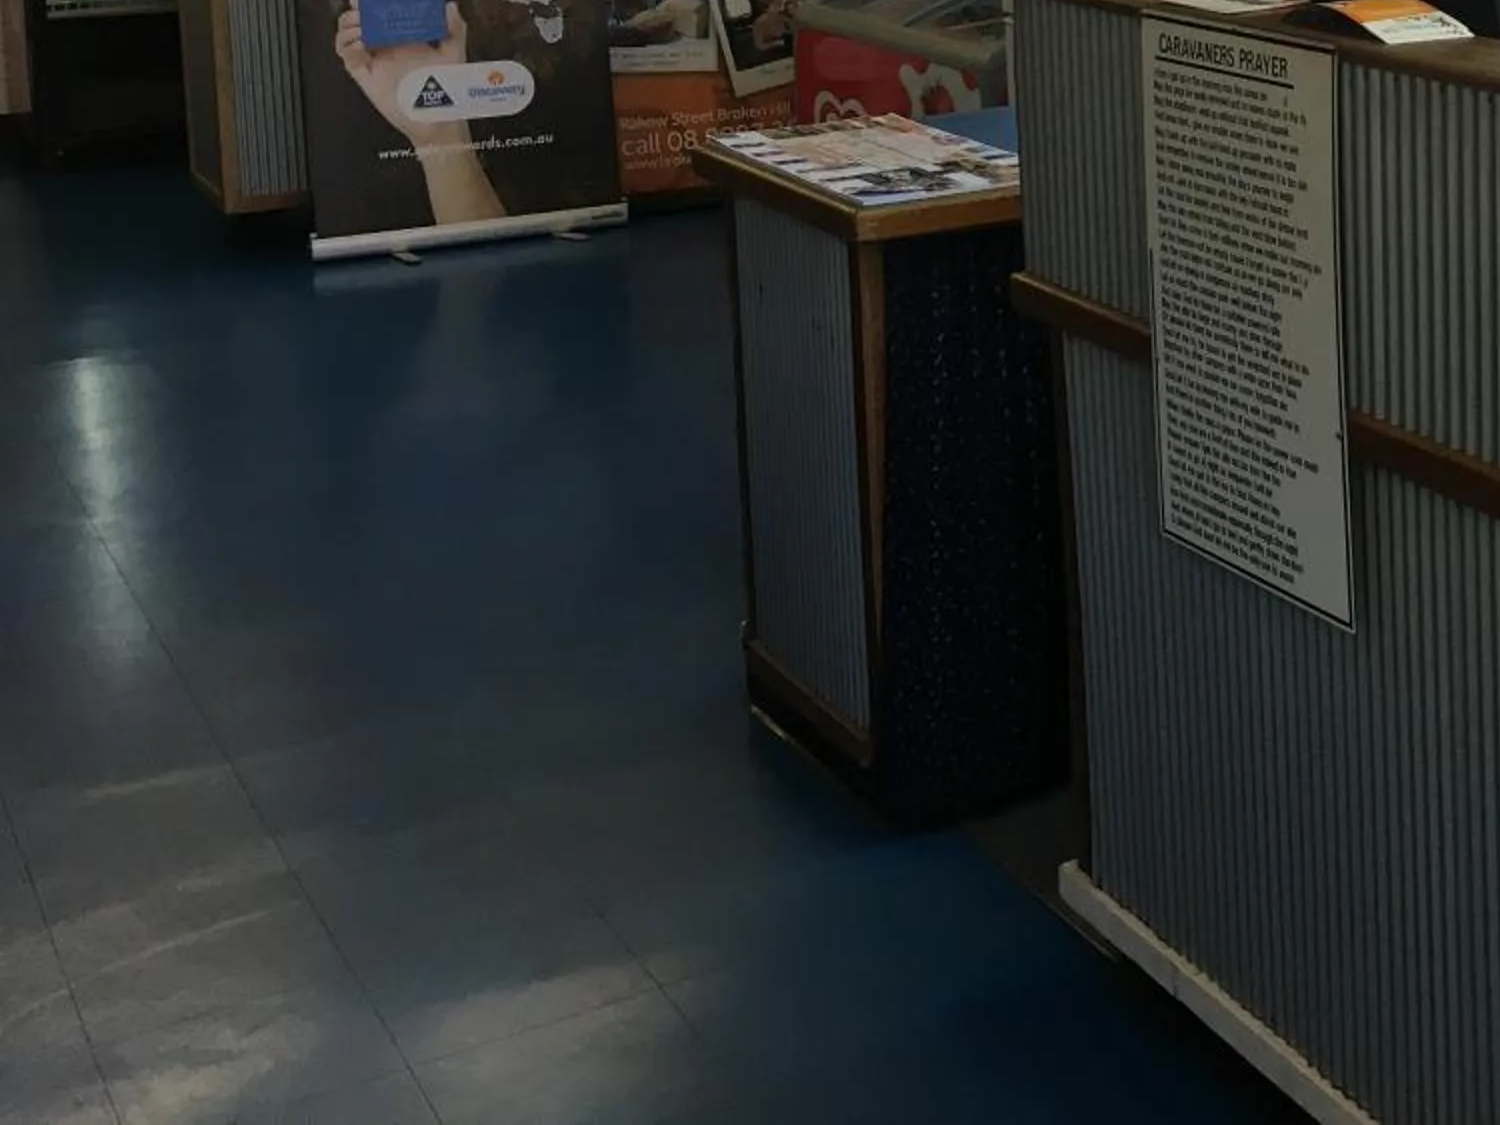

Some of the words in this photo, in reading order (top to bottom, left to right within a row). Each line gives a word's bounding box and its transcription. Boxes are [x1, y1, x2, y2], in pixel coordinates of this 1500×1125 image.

[1158, 32, 1236, 68] CARAVANERS
[1238, 50, 1289, 77] PRAYER
[621, 131, 662, 157] call
[667, 129, 698, 152] 08
